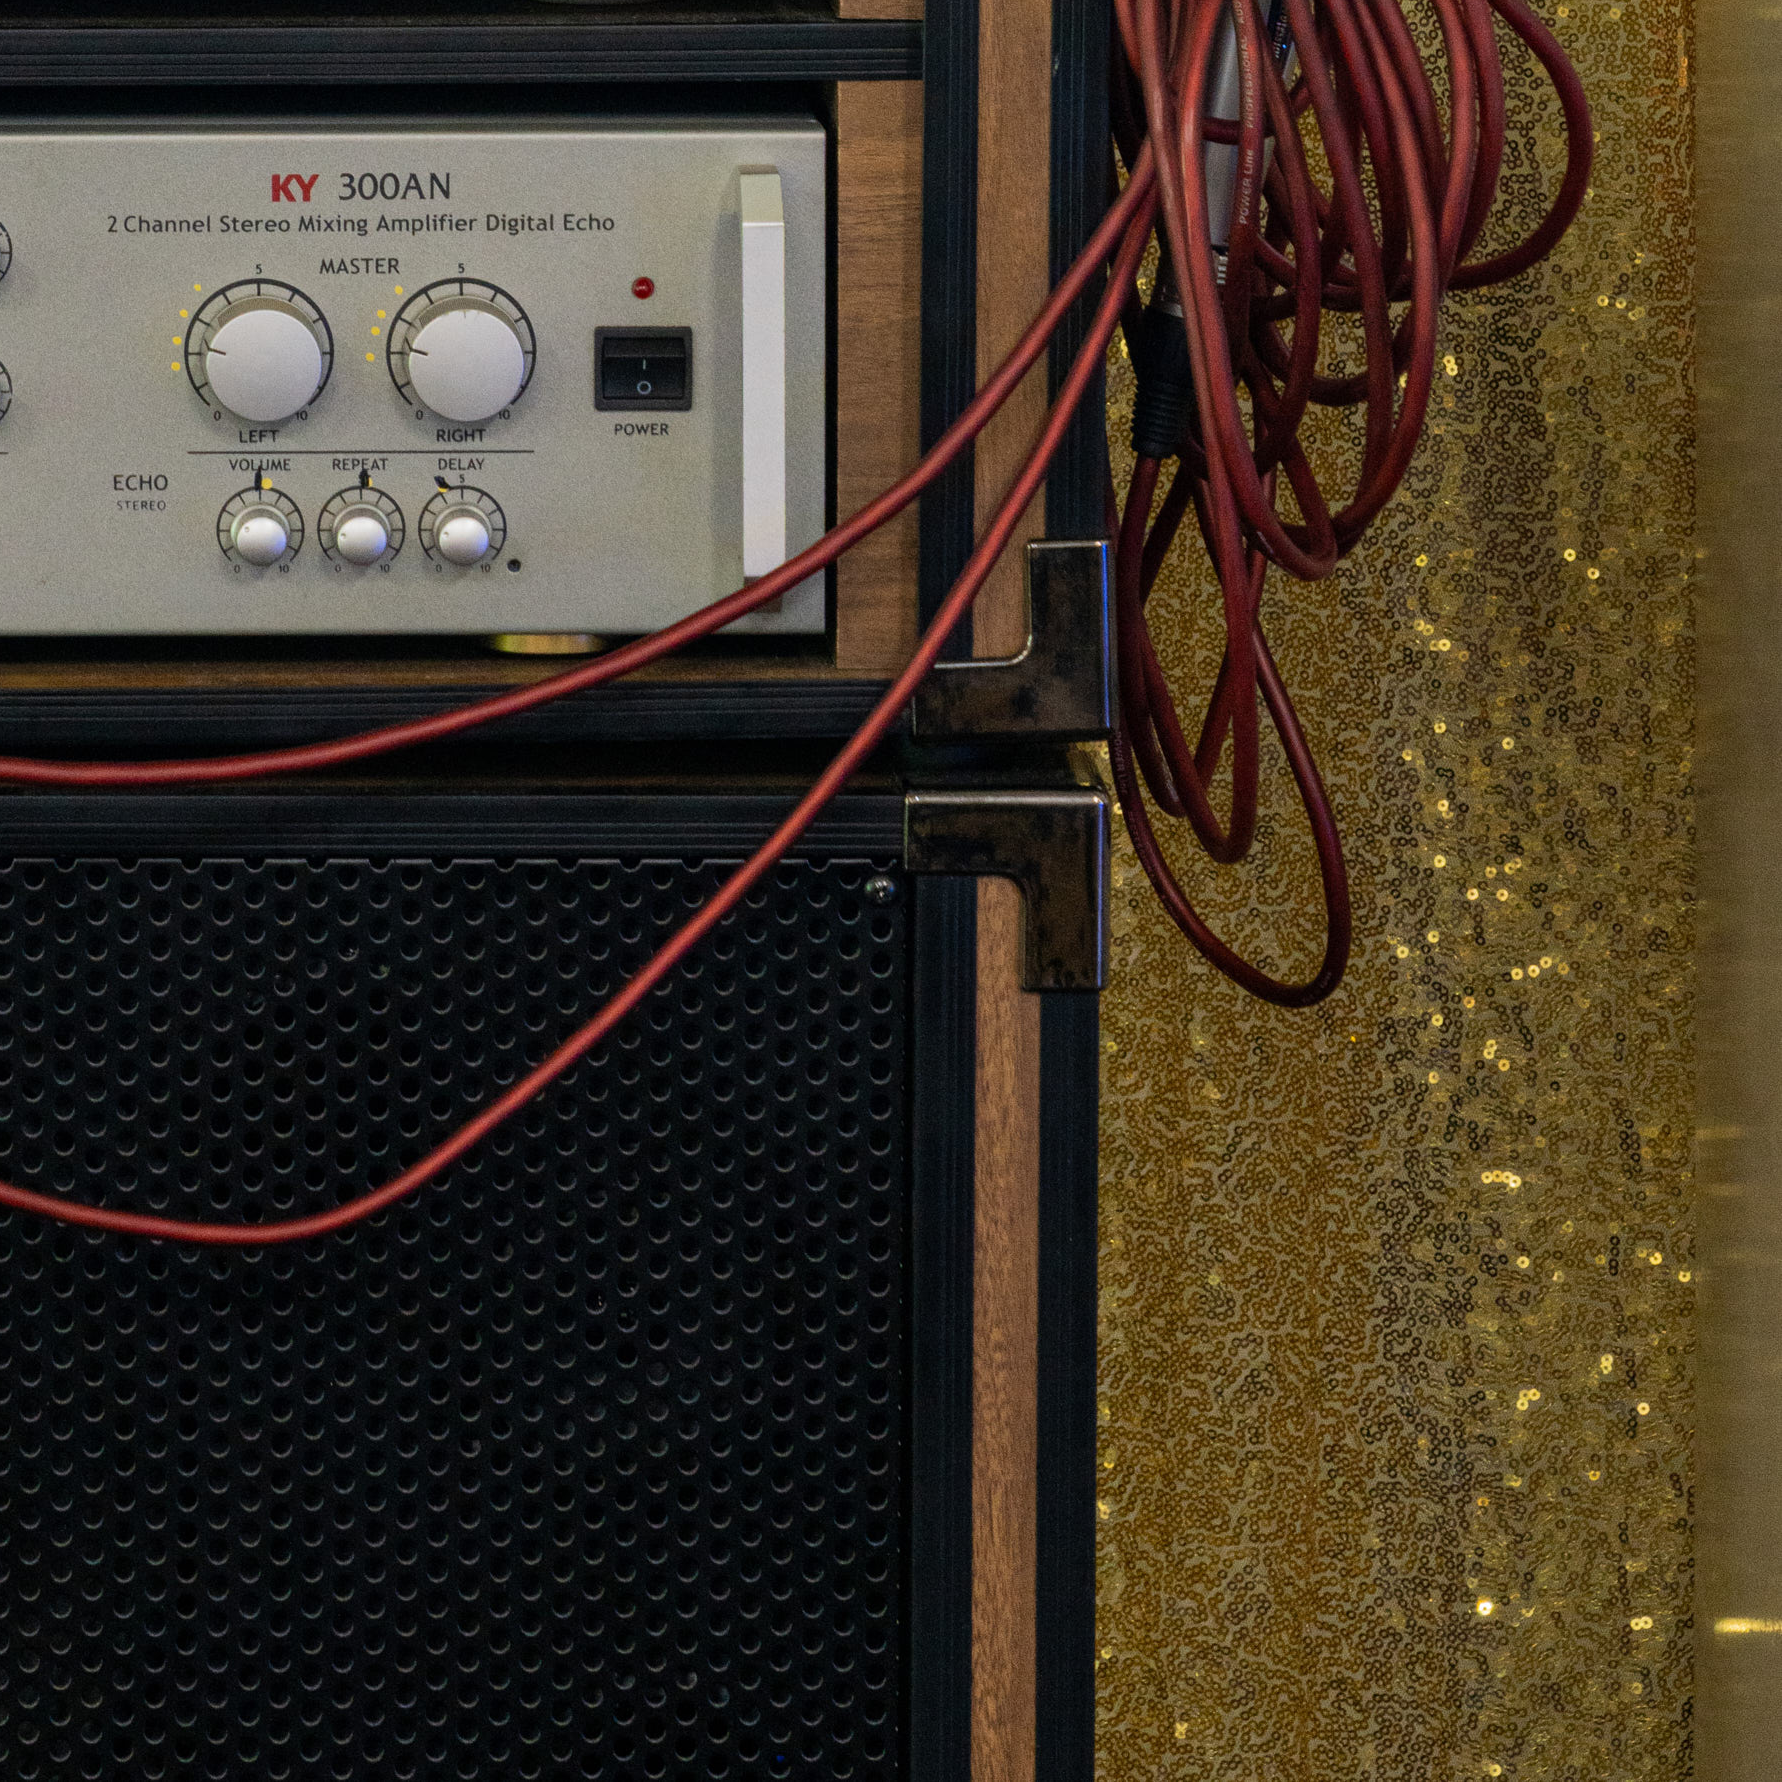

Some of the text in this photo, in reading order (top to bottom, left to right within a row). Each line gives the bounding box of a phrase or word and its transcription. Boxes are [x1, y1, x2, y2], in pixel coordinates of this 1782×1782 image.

[270, 172, 452, 202] KY 300AN
[1238, 180, 1251, 226] POWER
[107, 214, 615, 237] 2 Channel Stereo Mixing Amplifier Digital Echo
[256, 264, 262, 275] 5
[319, 258, 400, 275] MASTER
[458, 263, 465, 274] 5
[213, 410, 221, 422] 0
[416, 409, 423, 421] 0
[239, 429, 279, 443] LEFT
[436, 428, 486, 443] RIGHT
[614, 423, 669, 436] POWER
[228, 458, 292, 472] VOLUME
[332, 458, 389, 471] REPEAT
[437, 458, 485, 471] DELAY
[113, 474, 168, 492] ECHO
[116, 500, 166, 511] STEREO
